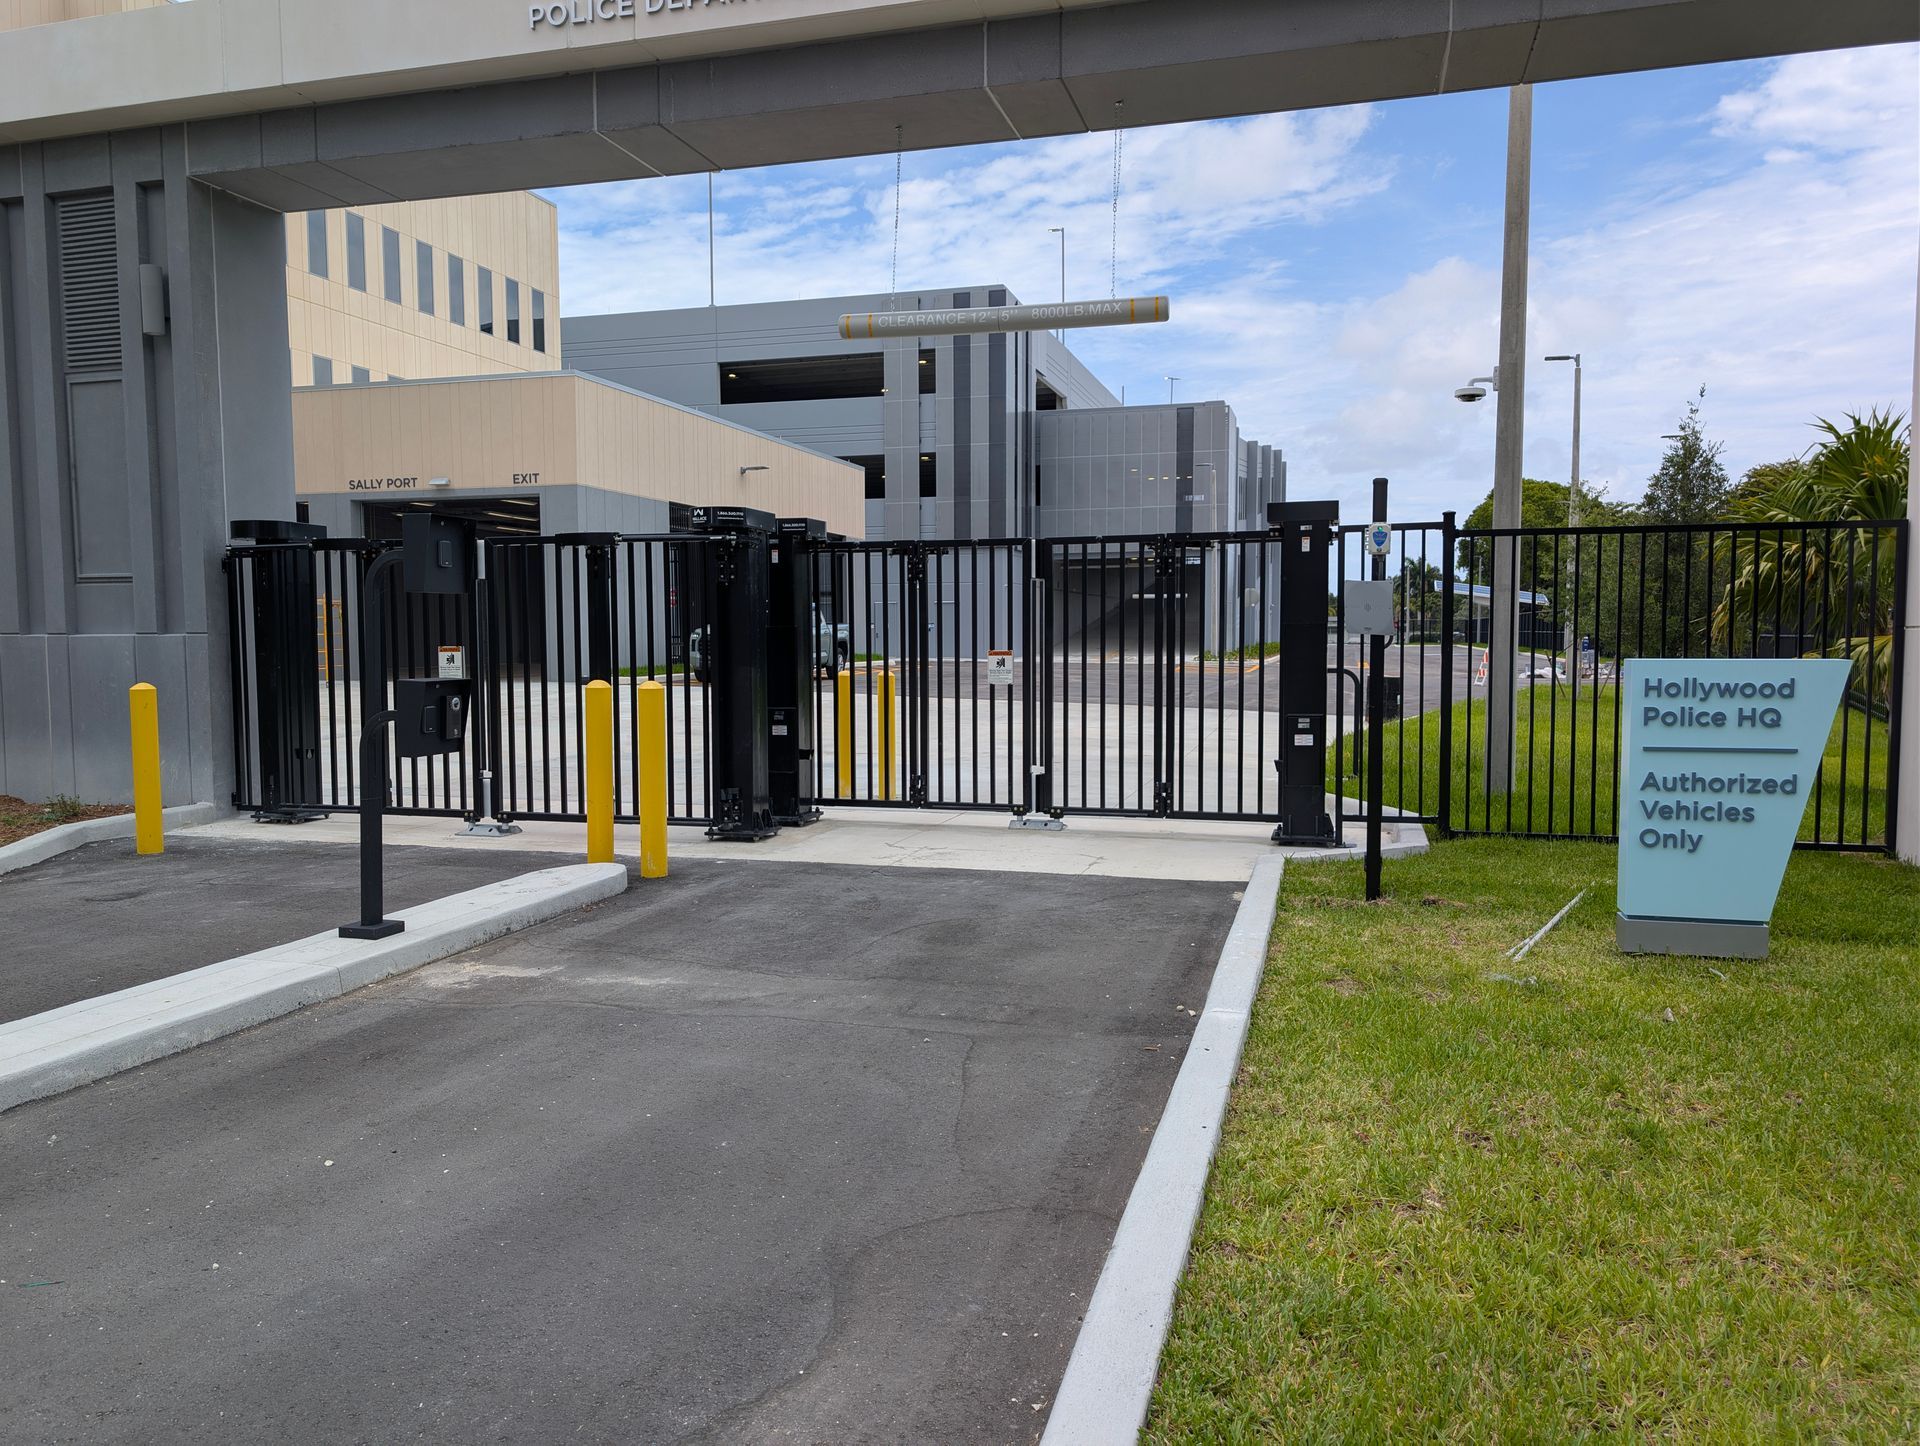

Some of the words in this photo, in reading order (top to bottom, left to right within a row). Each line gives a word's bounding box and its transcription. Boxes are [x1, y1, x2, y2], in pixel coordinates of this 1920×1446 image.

[528, 0, 634, 30] POLICE
[878, 312, 967, 329] CLEARANCE
[349, 478, 383, 490] SALLY
[386, 477, 418, 489] PORT
[512, 472, 540, 485] EXIT
[1643, 677, 1796, 701] Hollywood
[1642, 706, 1727, 727] Police
[1737, 706, 1783, 728] HQ
[1640, 771, 1798, 795] Authorized
[1639, 800, 1756, 823] Vehicles
[1638, 828, 1703, 853] Only
